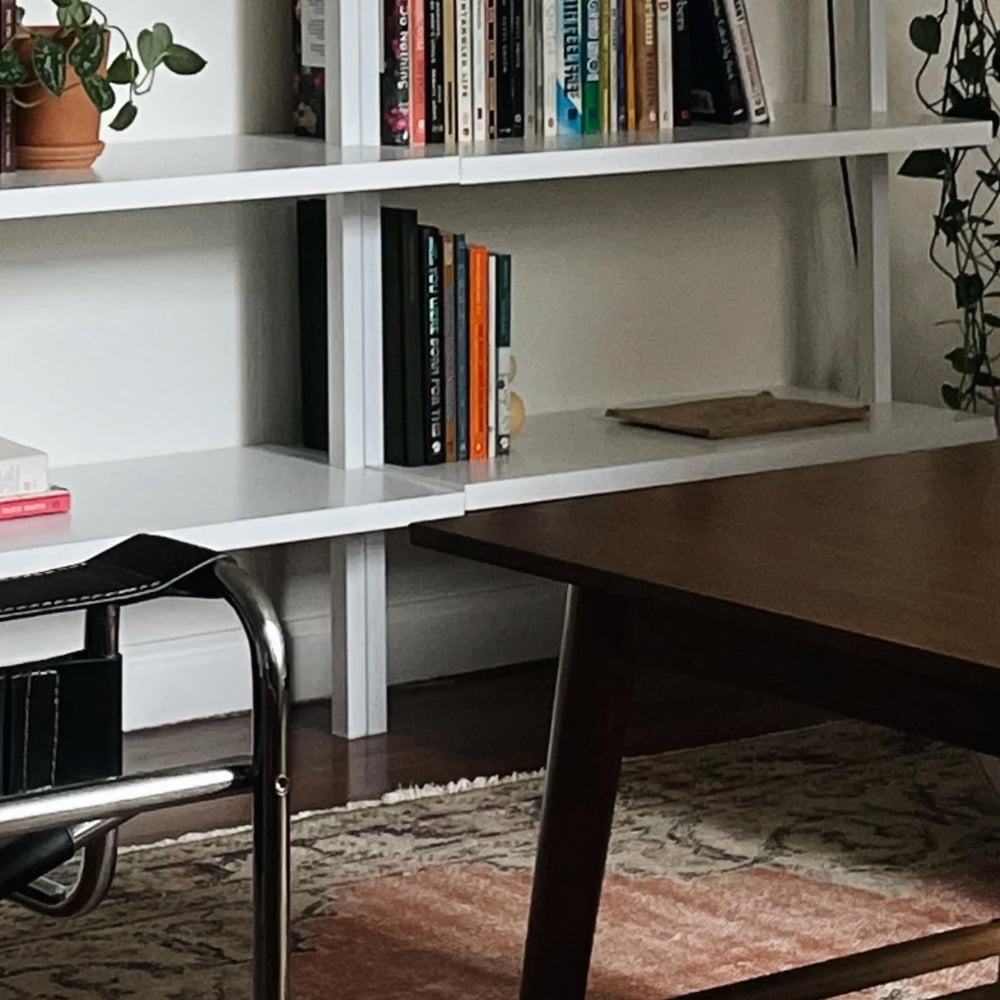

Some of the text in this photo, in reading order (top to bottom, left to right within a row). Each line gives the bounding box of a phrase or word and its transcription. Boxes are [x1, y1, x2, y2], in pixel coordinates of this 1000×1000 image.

[399, 31, 410, 89] Nothing
[563, 26, 580, 58] FEEL
[563, 60, 581, 100] FREE
[429, 267, 441, 438] YOU WERE BORN FOR THIS
